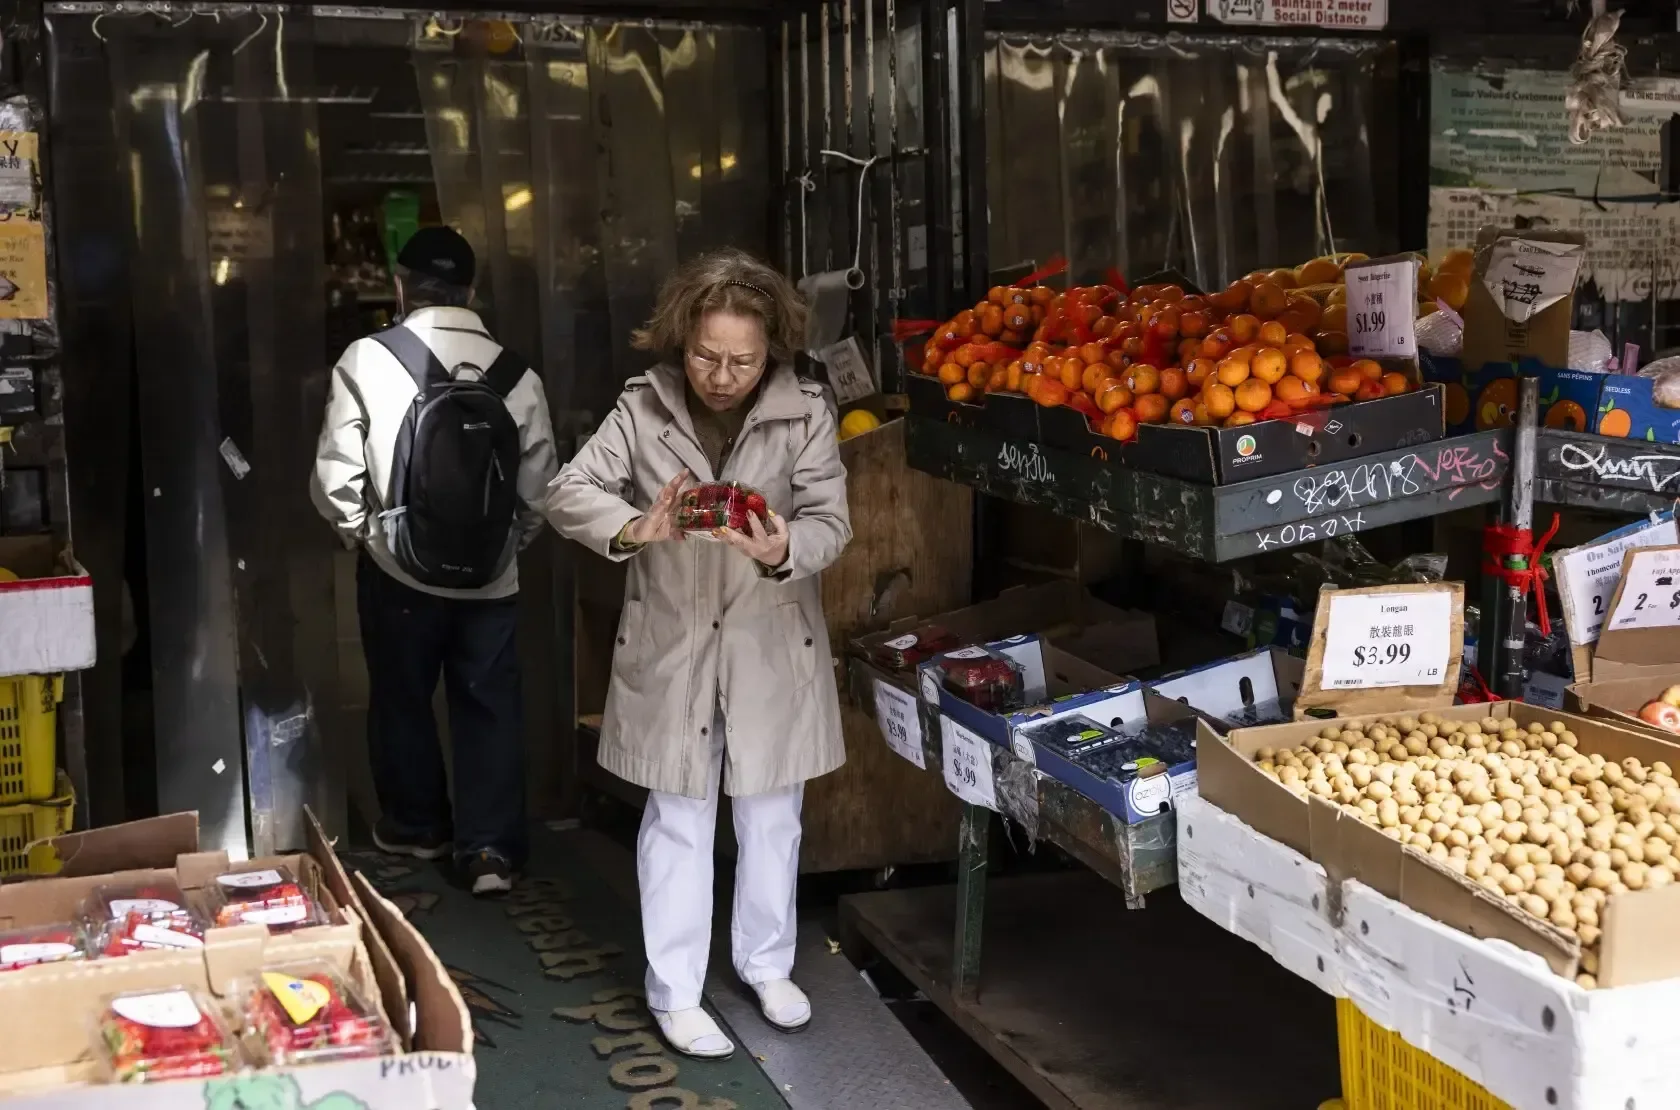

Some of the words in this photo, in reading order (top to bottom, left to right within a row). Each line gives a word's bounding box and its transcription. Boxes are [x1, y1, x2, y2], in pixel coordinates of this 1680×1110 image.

[1271, 0, 1323, 10] Maintain
[1327, 0, 1335, 10] 2
[1338, 1, 1372, 12] meter
[1274, 9, 1311, 23] Social
[1315, 10, 1368, 25] Distance
[1477, 89, 1510, 99] Valued
[1355, 310, 1386, 334] $1.99
[1397, 336, 1405, 345] LB
[1557, 372, 1571, 380] SANS
[1571, 372, 1593, 381] PÉPINS
[1604, 385, 1632, 395] SEEDLESS
[1232, 453, 1263, 465] PROPRIM
[1592, 595, 1604, 616] 2
[1634, 593, 1648, 611] 2
[1380, 604, 1408, 614] Longan
[1369, 624, 1414, 639] 散裝龍眼
[1352, 643, 1411, 668] $3.99
[1427, 668, 1438, 676] LB
[953, 758, 977, 788] $6.99
